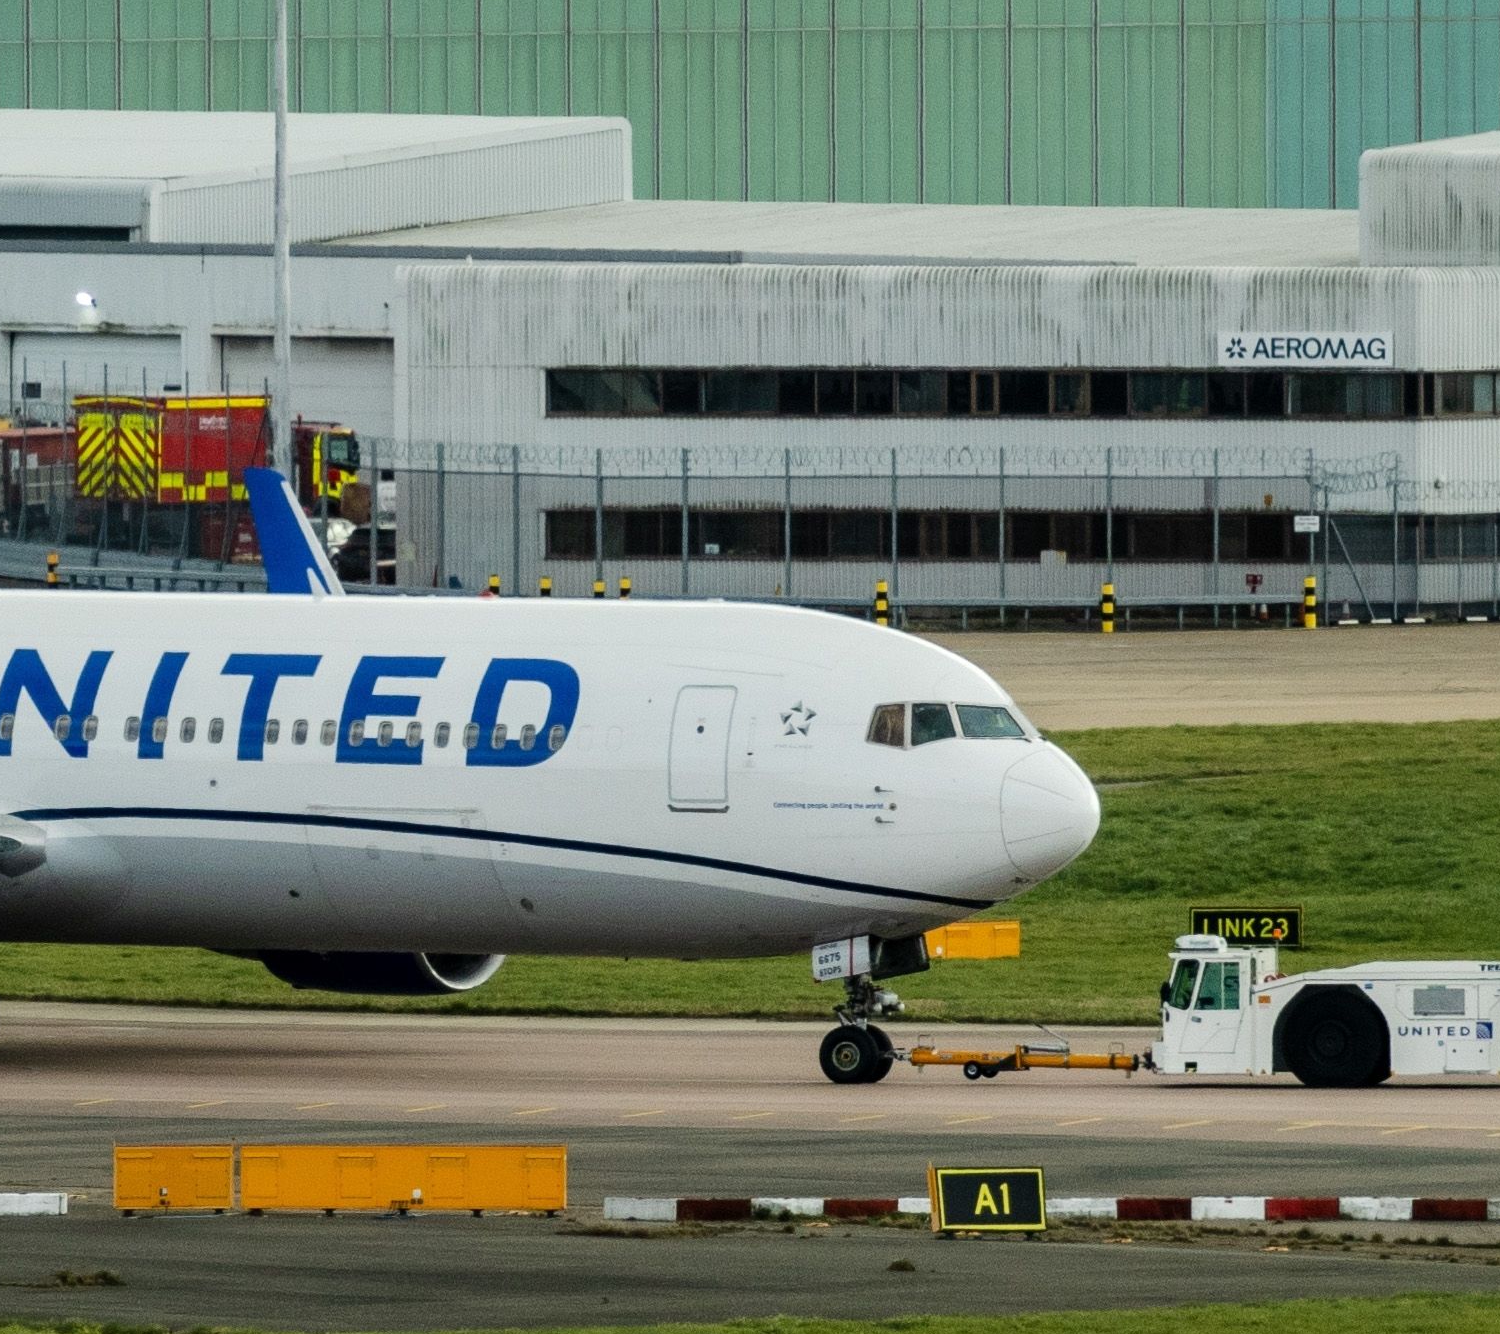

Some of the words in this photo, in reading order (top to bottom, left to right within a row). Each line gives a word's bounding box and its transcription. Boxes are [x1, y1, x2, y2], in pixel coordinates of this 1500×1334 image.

[1252, 337, 1386, 359] AEROMAG
[818, 951, 841, 965] 6675
[1398, 1026, 1470, 1037] UNITED
[974, 1182, 1010, 1216] A1
